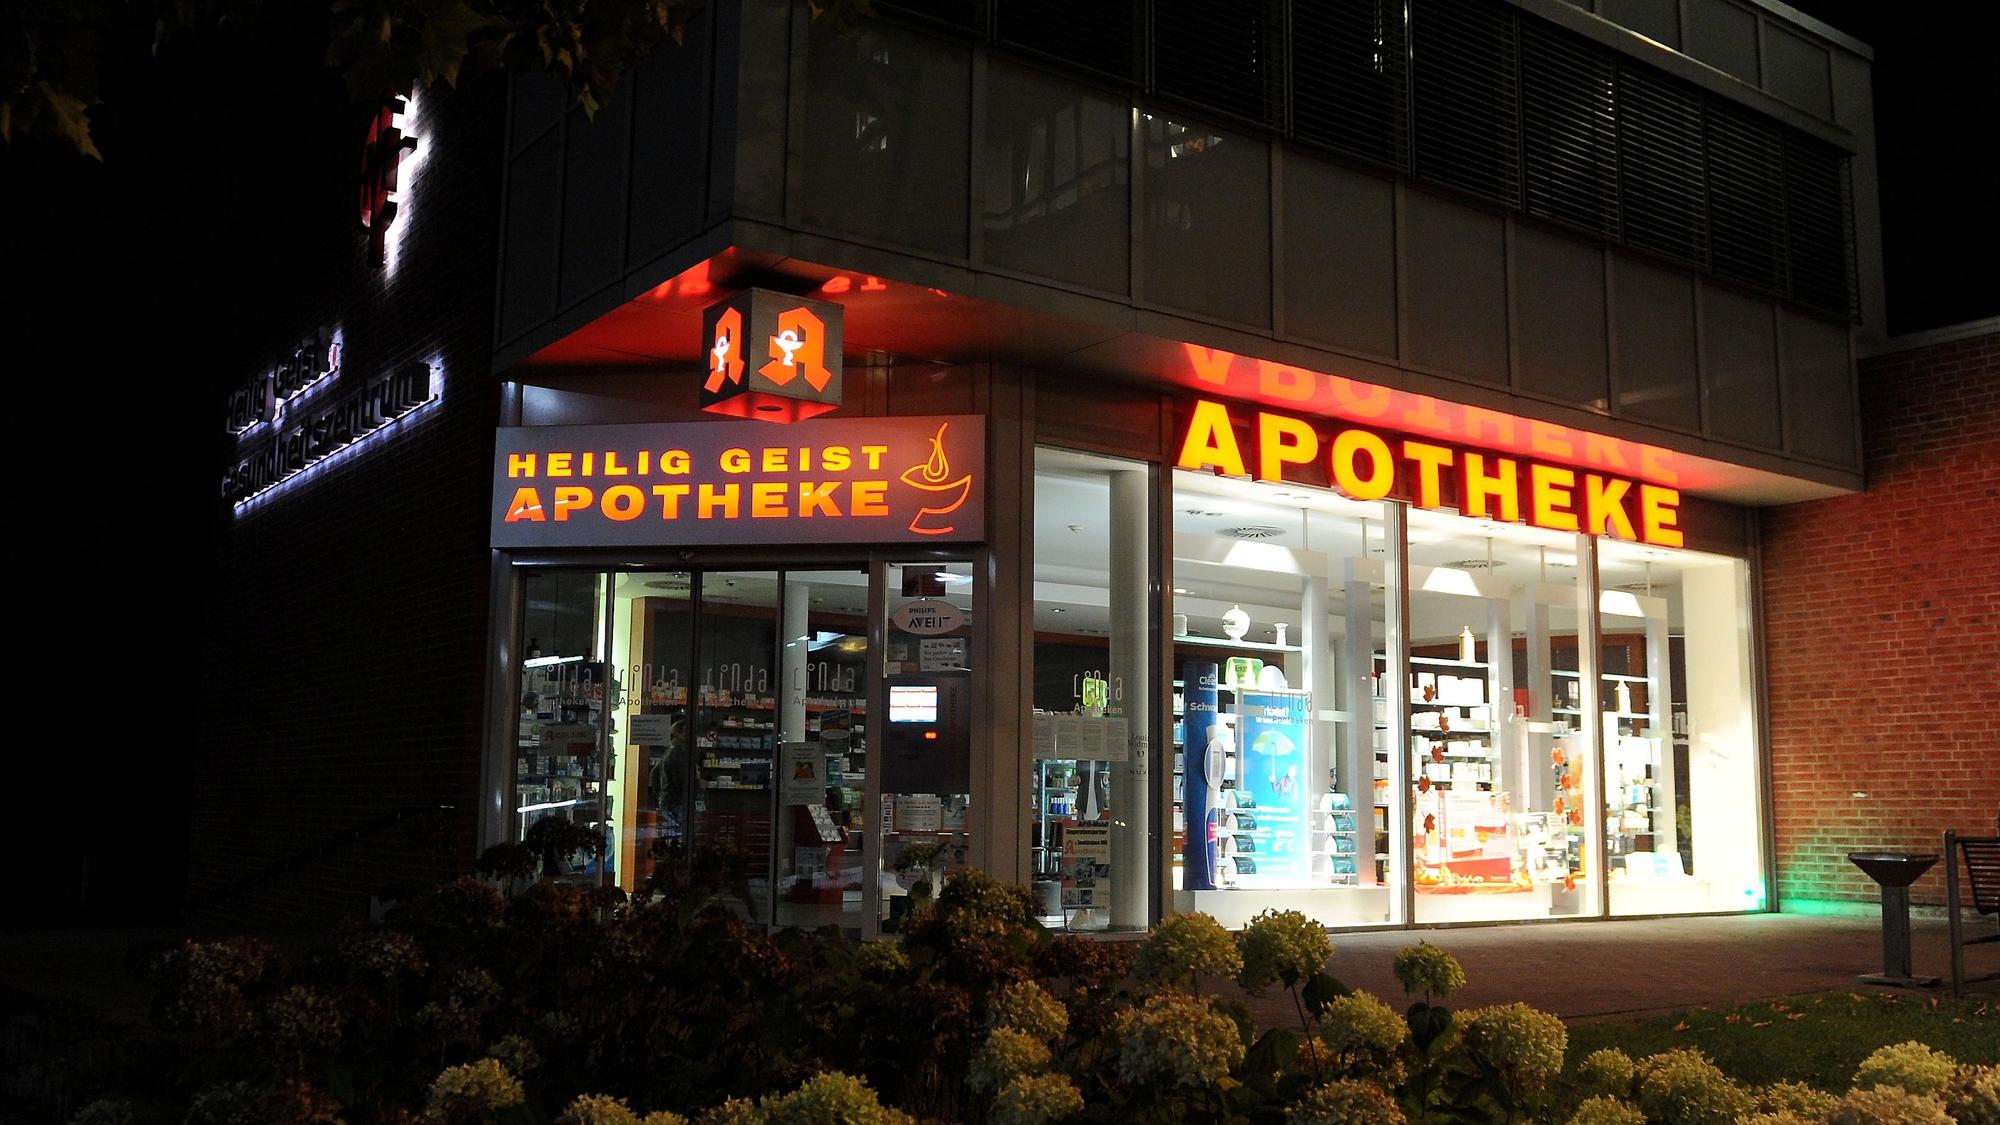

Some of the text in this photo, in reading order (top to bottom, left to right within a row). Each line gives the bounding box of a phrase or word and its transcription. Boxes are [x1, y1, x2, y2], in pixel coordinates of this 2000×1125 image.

[758, 306, 832, 393] A
[507, 444, 888, 478] HEILIG GEIST
[1177, 400, 1685, 548] APOTHEKE
[504, 480, 890, 522] APOTHEKE
